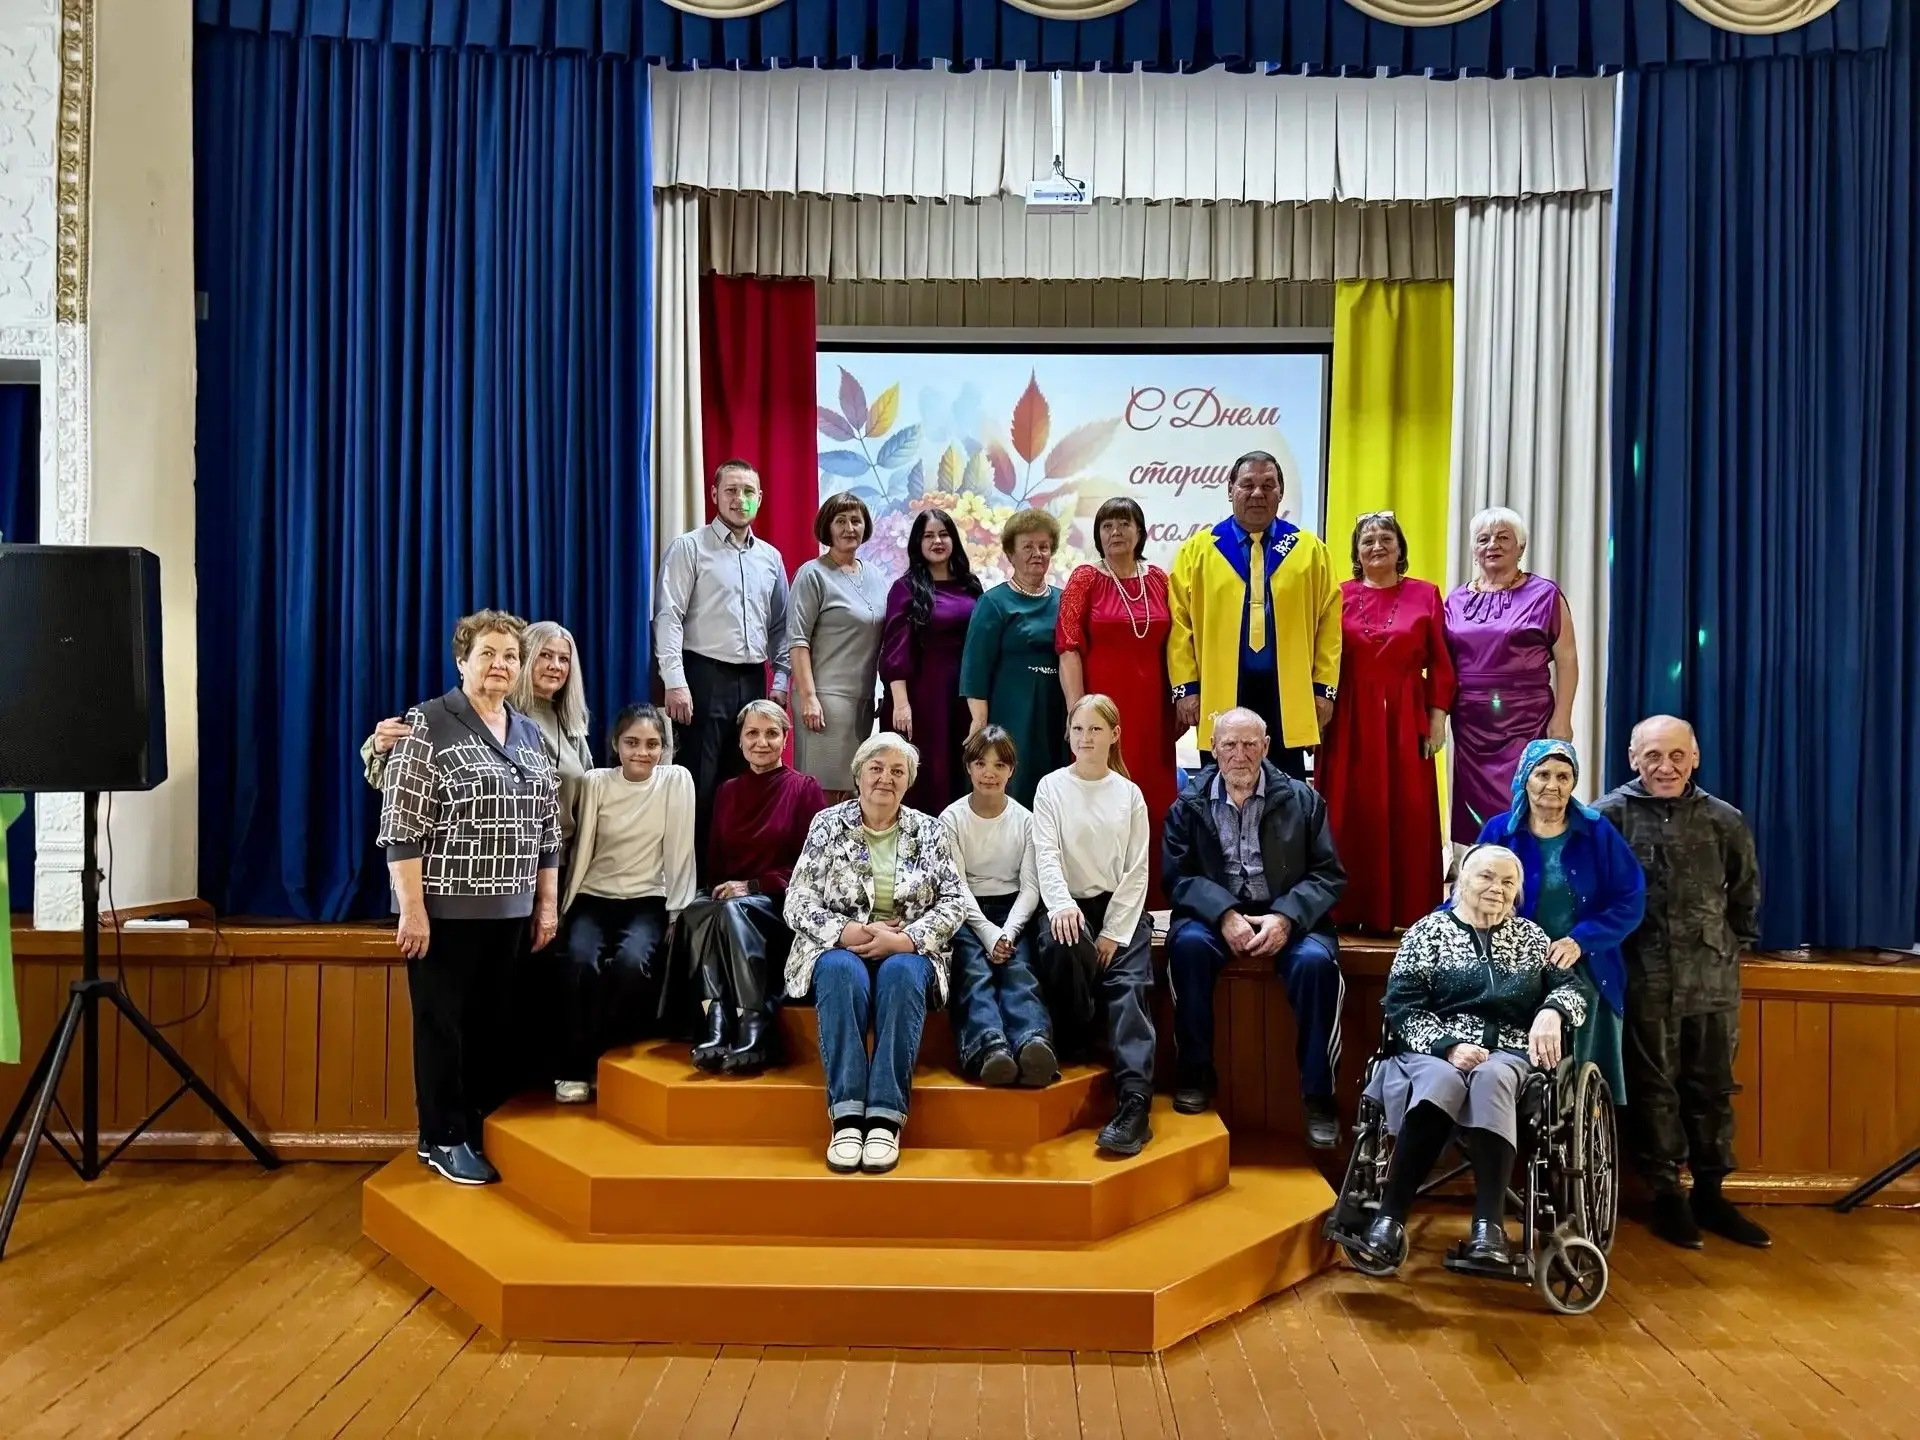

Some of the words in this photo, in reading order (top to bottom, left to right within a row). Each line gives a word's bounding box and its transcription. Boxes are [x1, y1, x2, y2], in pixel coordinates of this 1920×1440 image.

[1125, 386, 1166, 431] С
[1169, 386, 1281, 429] Днем
[1129, 461, 1230, 498] старш
